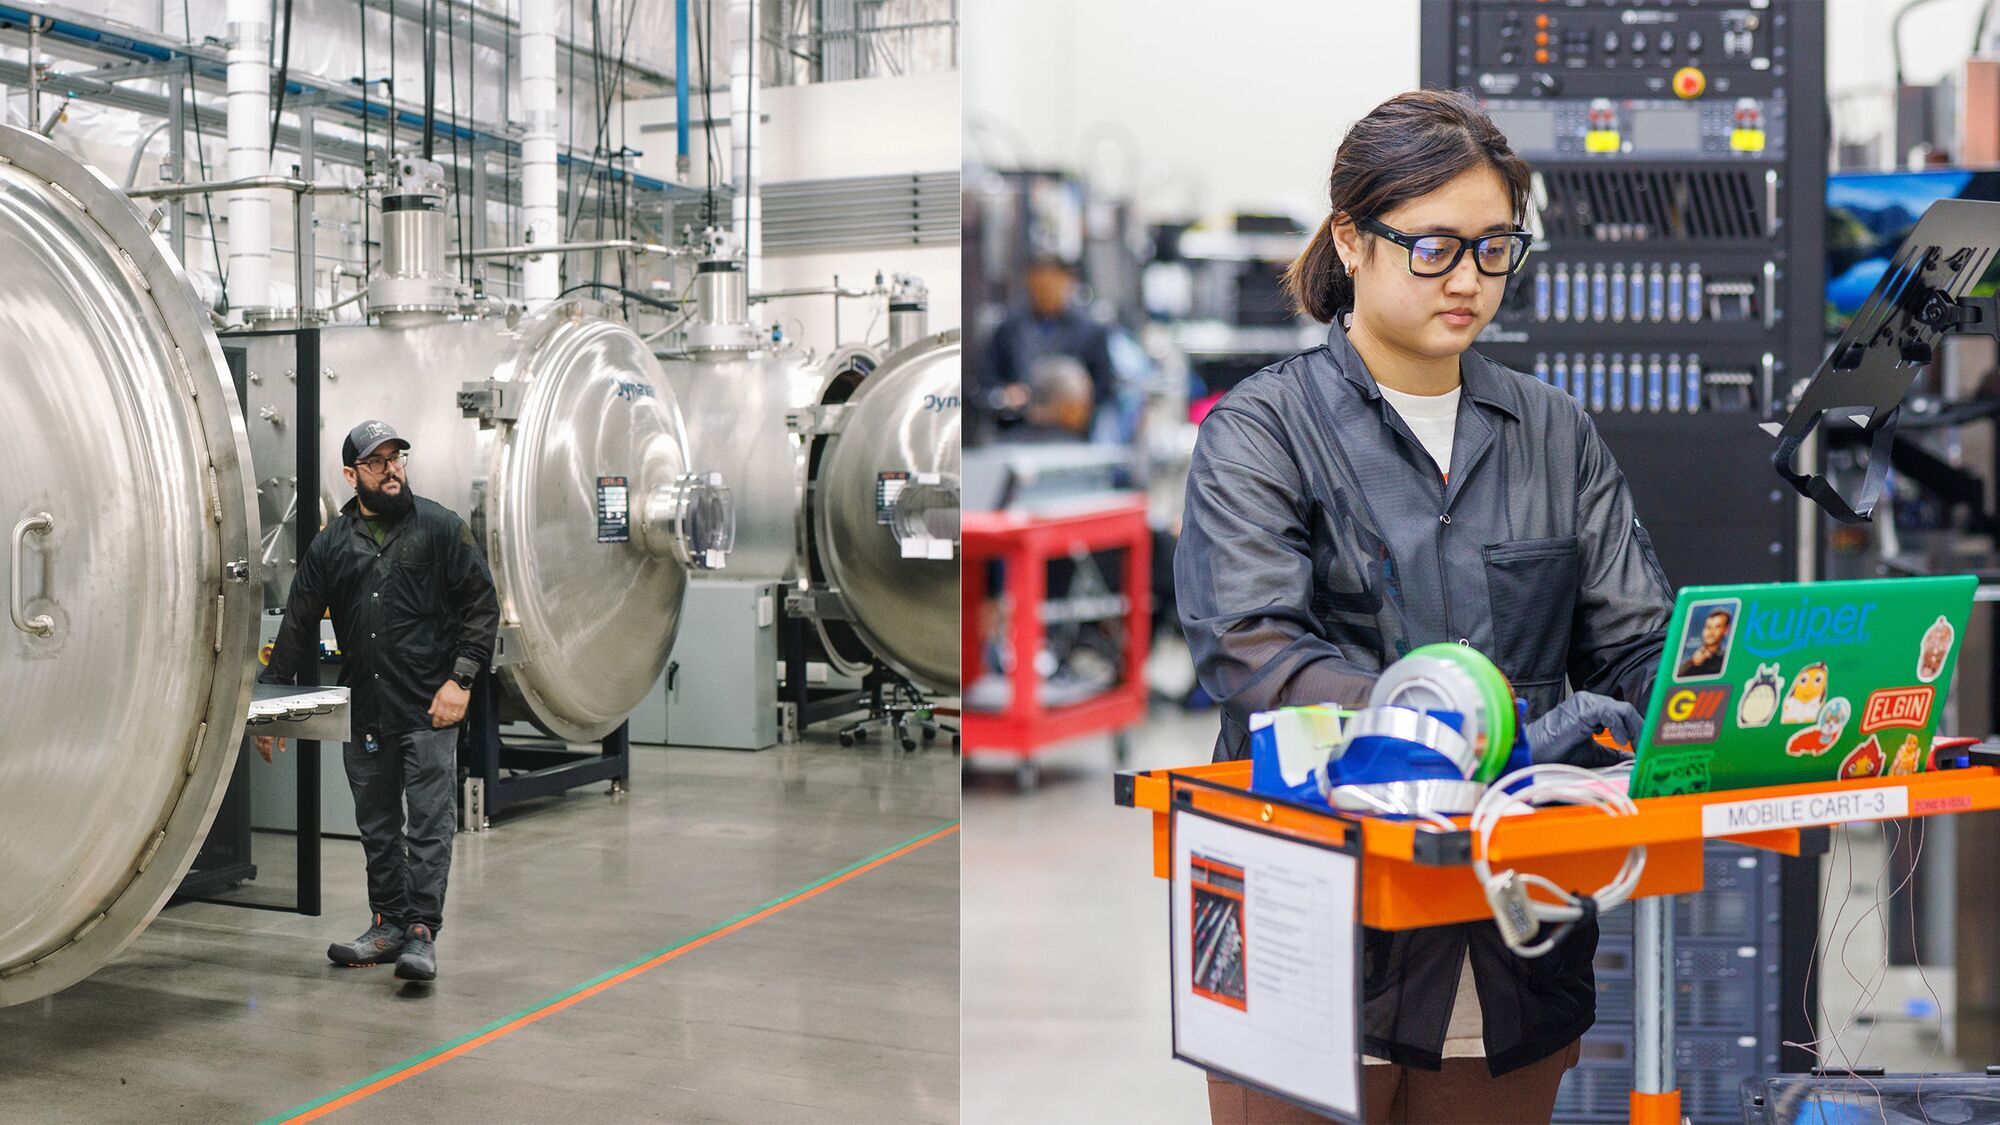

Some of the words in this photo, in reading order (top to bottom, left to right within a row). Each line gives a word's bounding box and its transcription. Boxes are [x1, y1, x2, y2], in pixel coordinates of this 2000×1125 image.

[923, 394, 961, 413] Dyn
[1743, 596, 1878, 646] kuiper
[1870, 694, 1926, 723] ELGIN
[1728, 799, 1801, 827] MOBILE
[1809, 792, 1885, 819] CART-3
